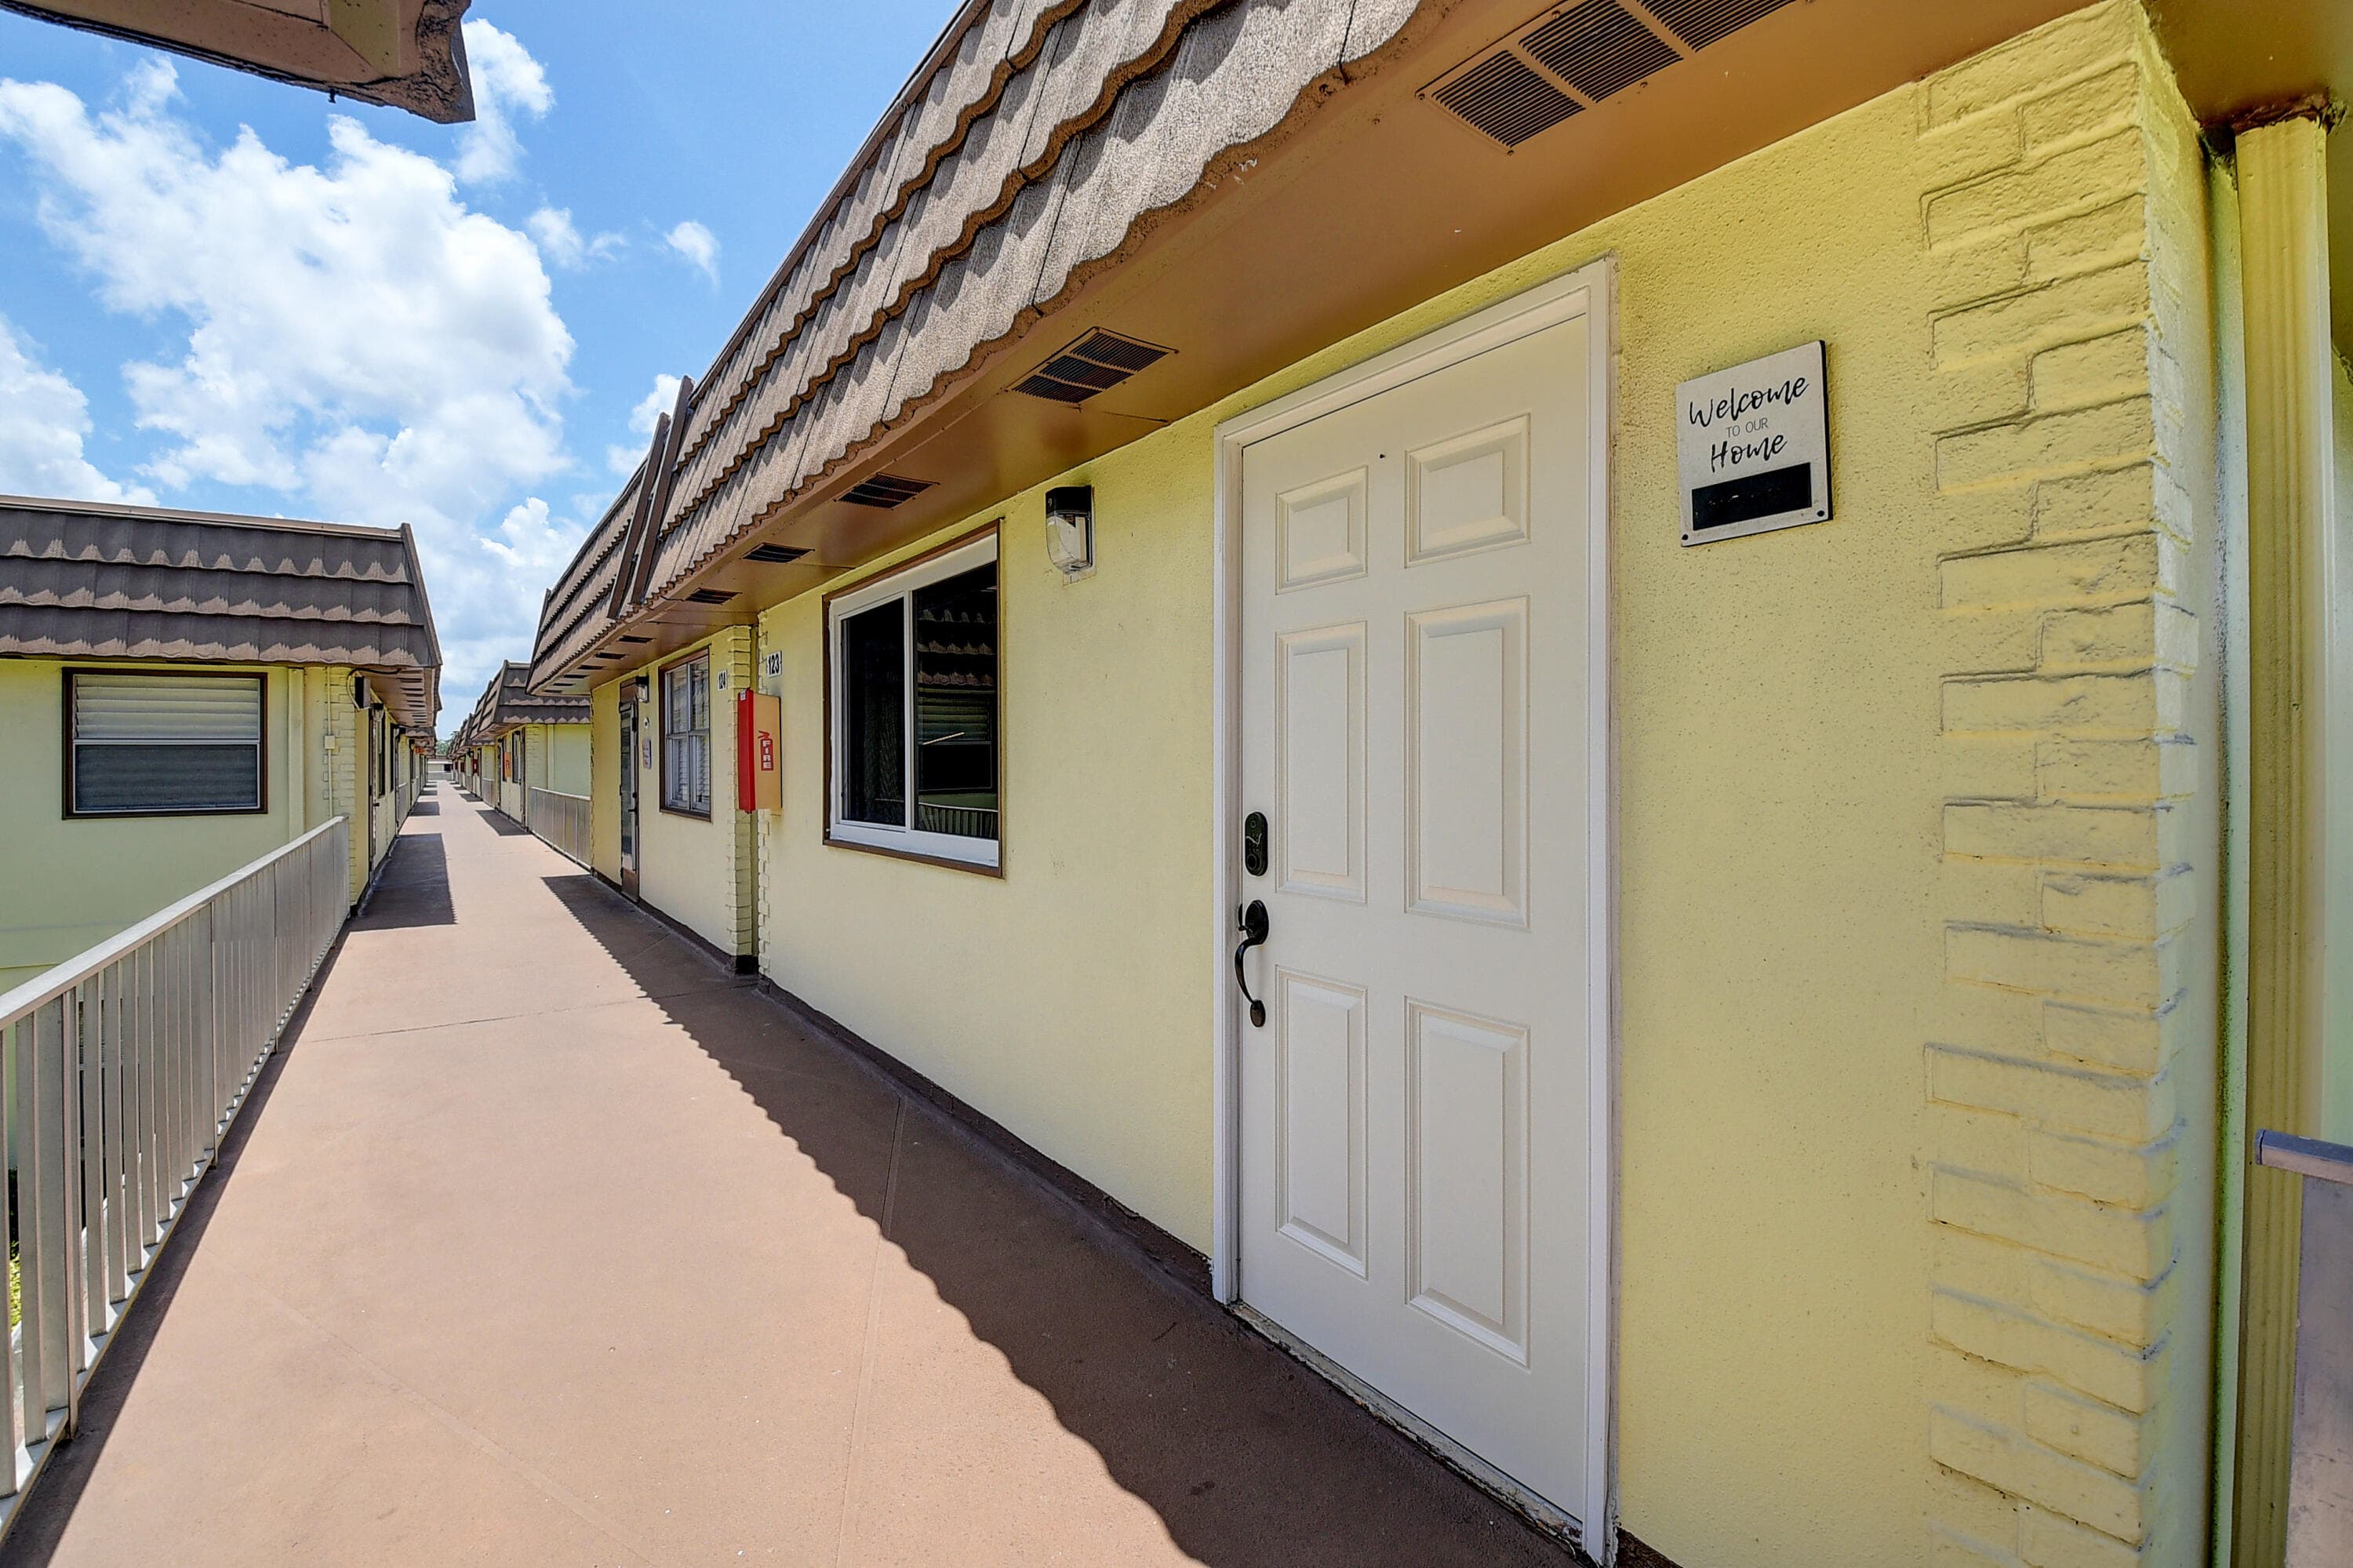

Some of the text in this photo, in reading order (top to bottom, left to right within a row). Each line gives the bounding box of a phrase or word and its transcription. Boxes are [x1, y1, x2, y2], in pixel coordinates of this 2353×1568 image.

[1689, 377, 1810, 427] Welcome
[1726, 417, 1769, 438] TO OUR
[1711, 434, 1788, 473] Home
[769, 653, 780, 675] 123
[762, 740, 772, 769] FIRE
